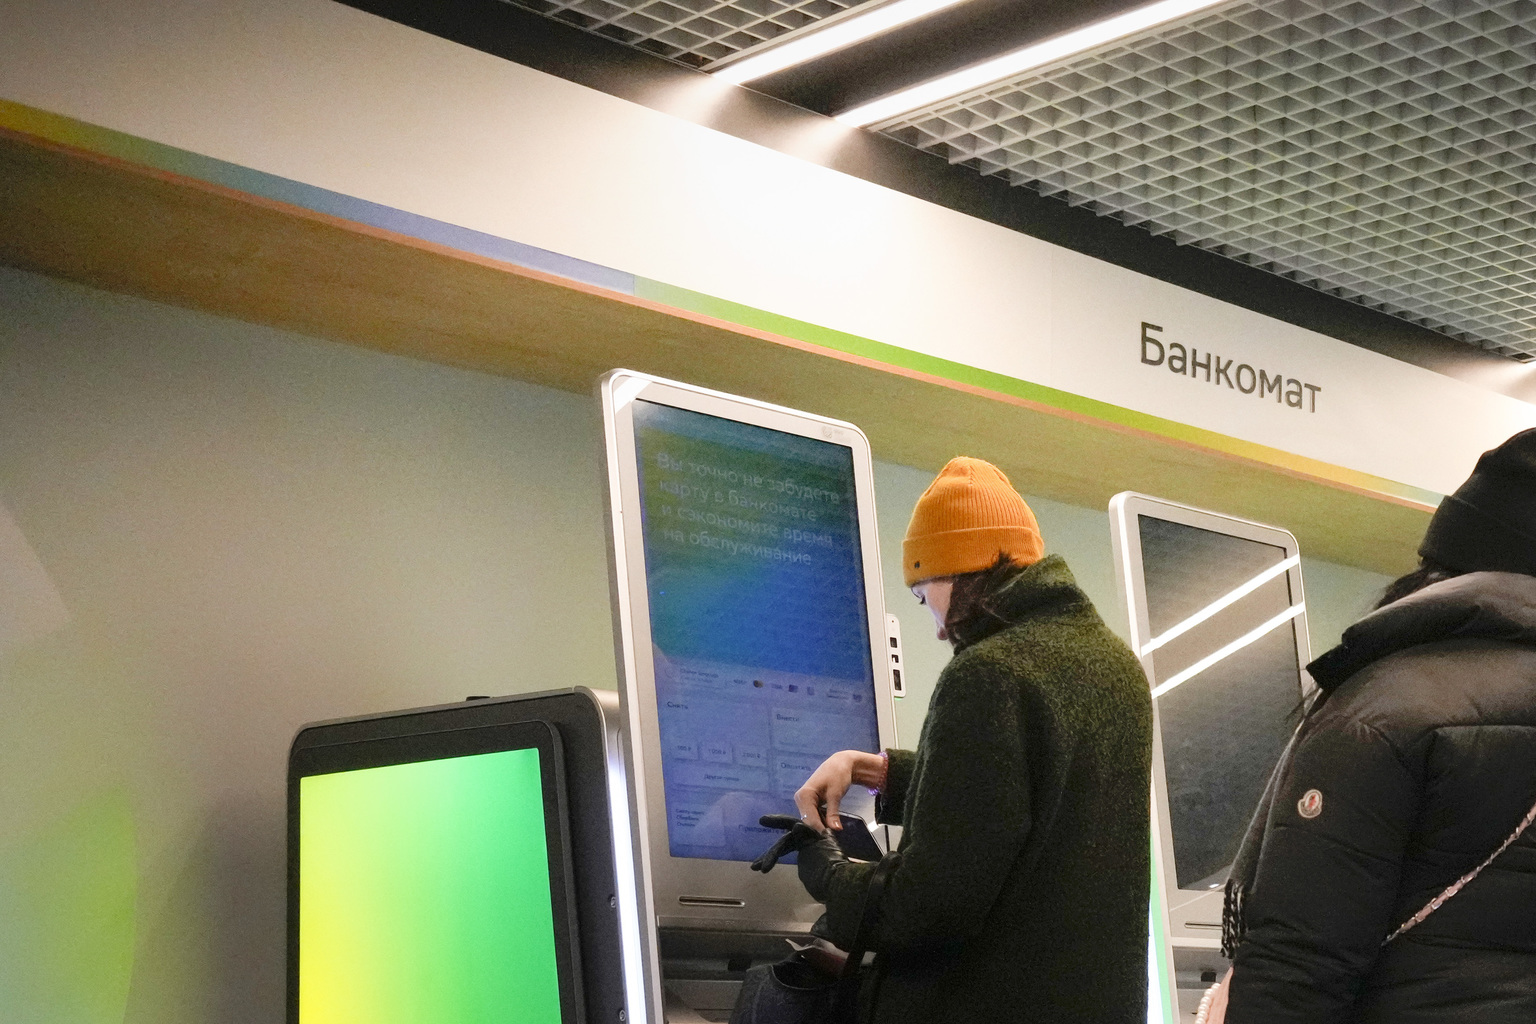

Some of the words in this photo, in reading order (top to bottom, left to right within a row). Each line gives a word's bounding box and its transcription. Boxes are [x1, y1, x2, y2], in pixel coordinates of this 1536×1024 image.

[1140, 321, 1322, 413] Банкомат
[657, 452, 682, 470] Вы
[688, 462, 738, 484] точно
[744, 475, 763, 488] не
[768, 479, 840, 504] забудете
[660, 480, 710, 503] карту
[715, 491, 724, 503] в
[728, 490, 817, 521] банкомате
[661, 504, 672, 516] и
[677, 509, 778, 537] сэкономите
[784, 528, 833, 547] время
[664, 529, 684, 543] на
[689, 531, 812, 565] обслуживание
